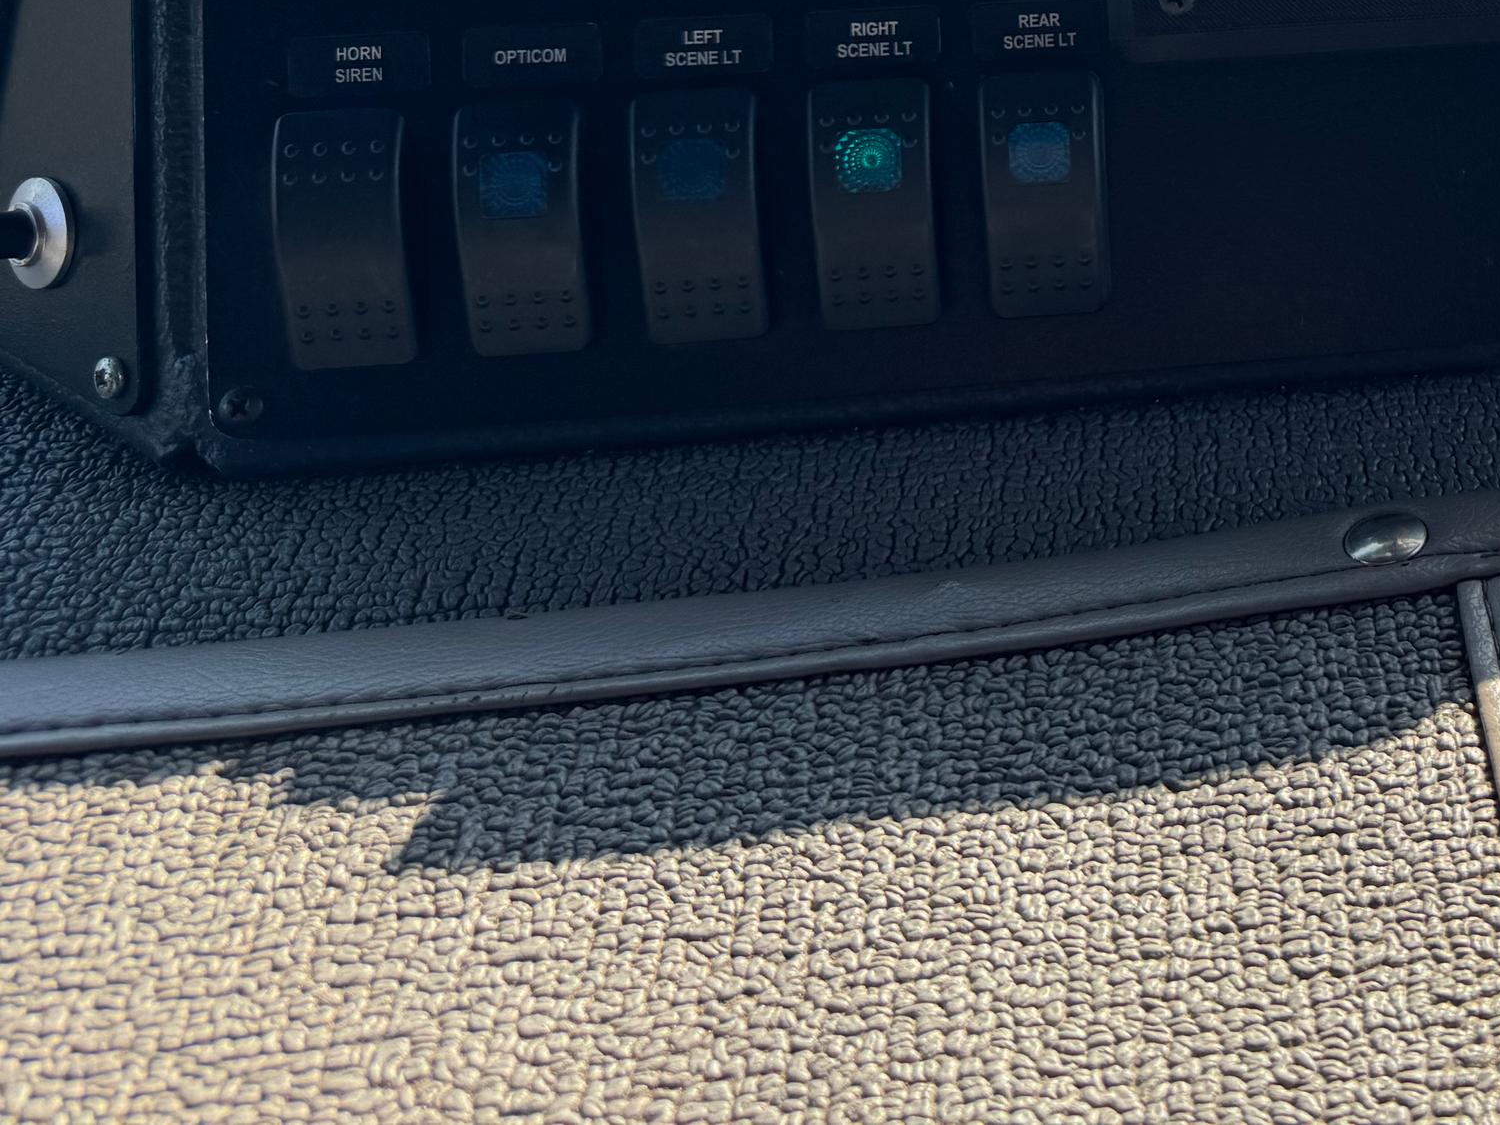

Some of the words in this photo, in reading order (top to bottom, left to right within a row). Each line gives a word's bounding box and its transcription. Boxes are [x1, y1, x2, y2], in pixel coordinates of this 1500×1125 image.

[1019, 13, 1060, 27] REAR
[851, 21, 898, 36] RIGHT
[685, 30, 723, 44] LEFT
[1004, 34, 1054, 49] SCENE
[1059, 32, 1076, 46] LT
[337, 46, 381, 61] HORN
[495, 48, 566, 64] OPTICOM
[838, 42, 889, 57] SCENE
[894, 41, 912, 55] LT
[666, 51, 718, 66] SCENE
[724, 50, 742, 64] LT
[336, 68, 382, 82] SIREN
